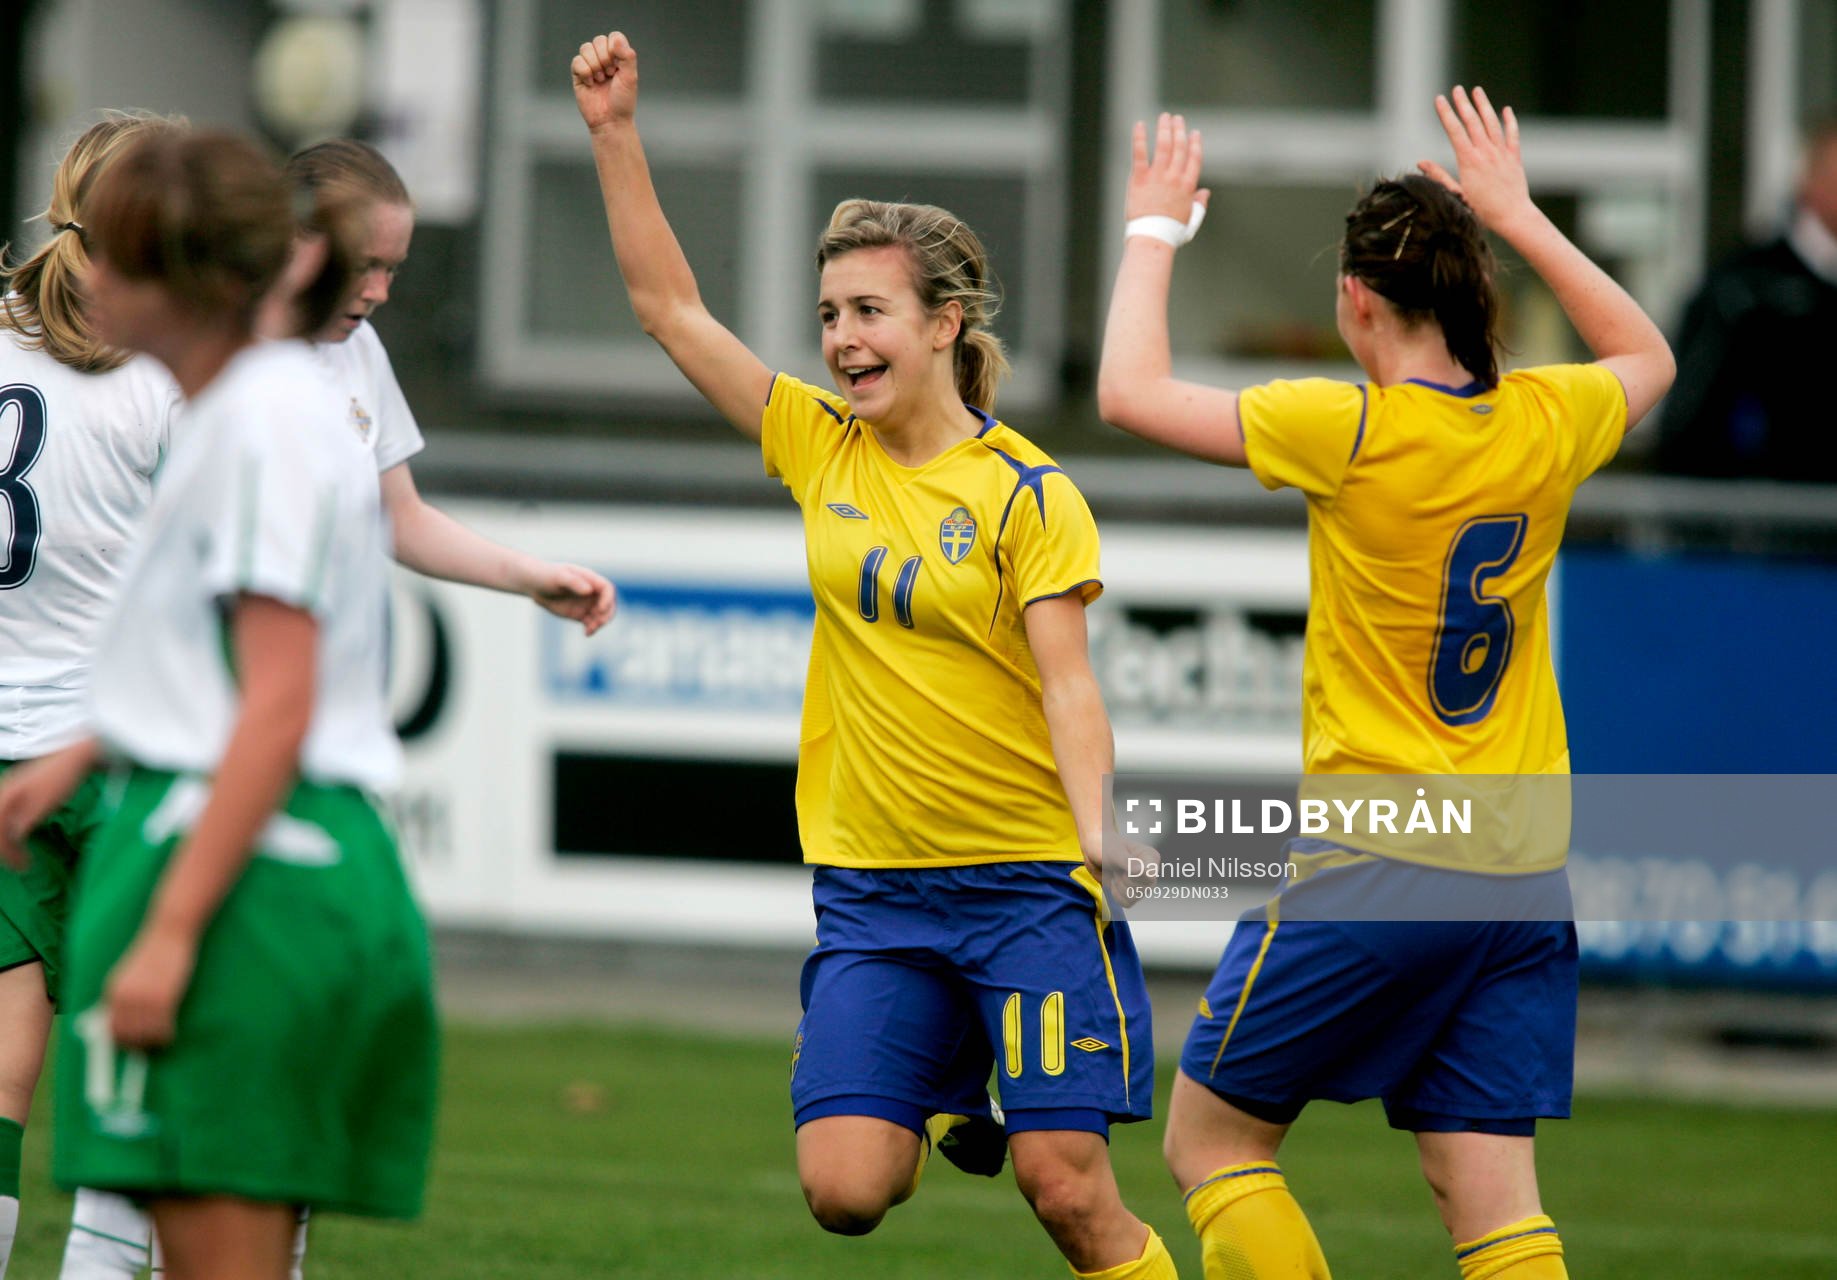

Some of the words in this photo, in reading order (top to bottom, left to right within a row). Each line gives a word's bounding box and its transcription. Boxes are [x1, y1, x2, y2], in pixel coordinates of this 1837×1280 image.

[857, 545, 924, 630] 11
[1426, 513, 1529, 727] 6
[1002, 991, 1066, 1079] 11
